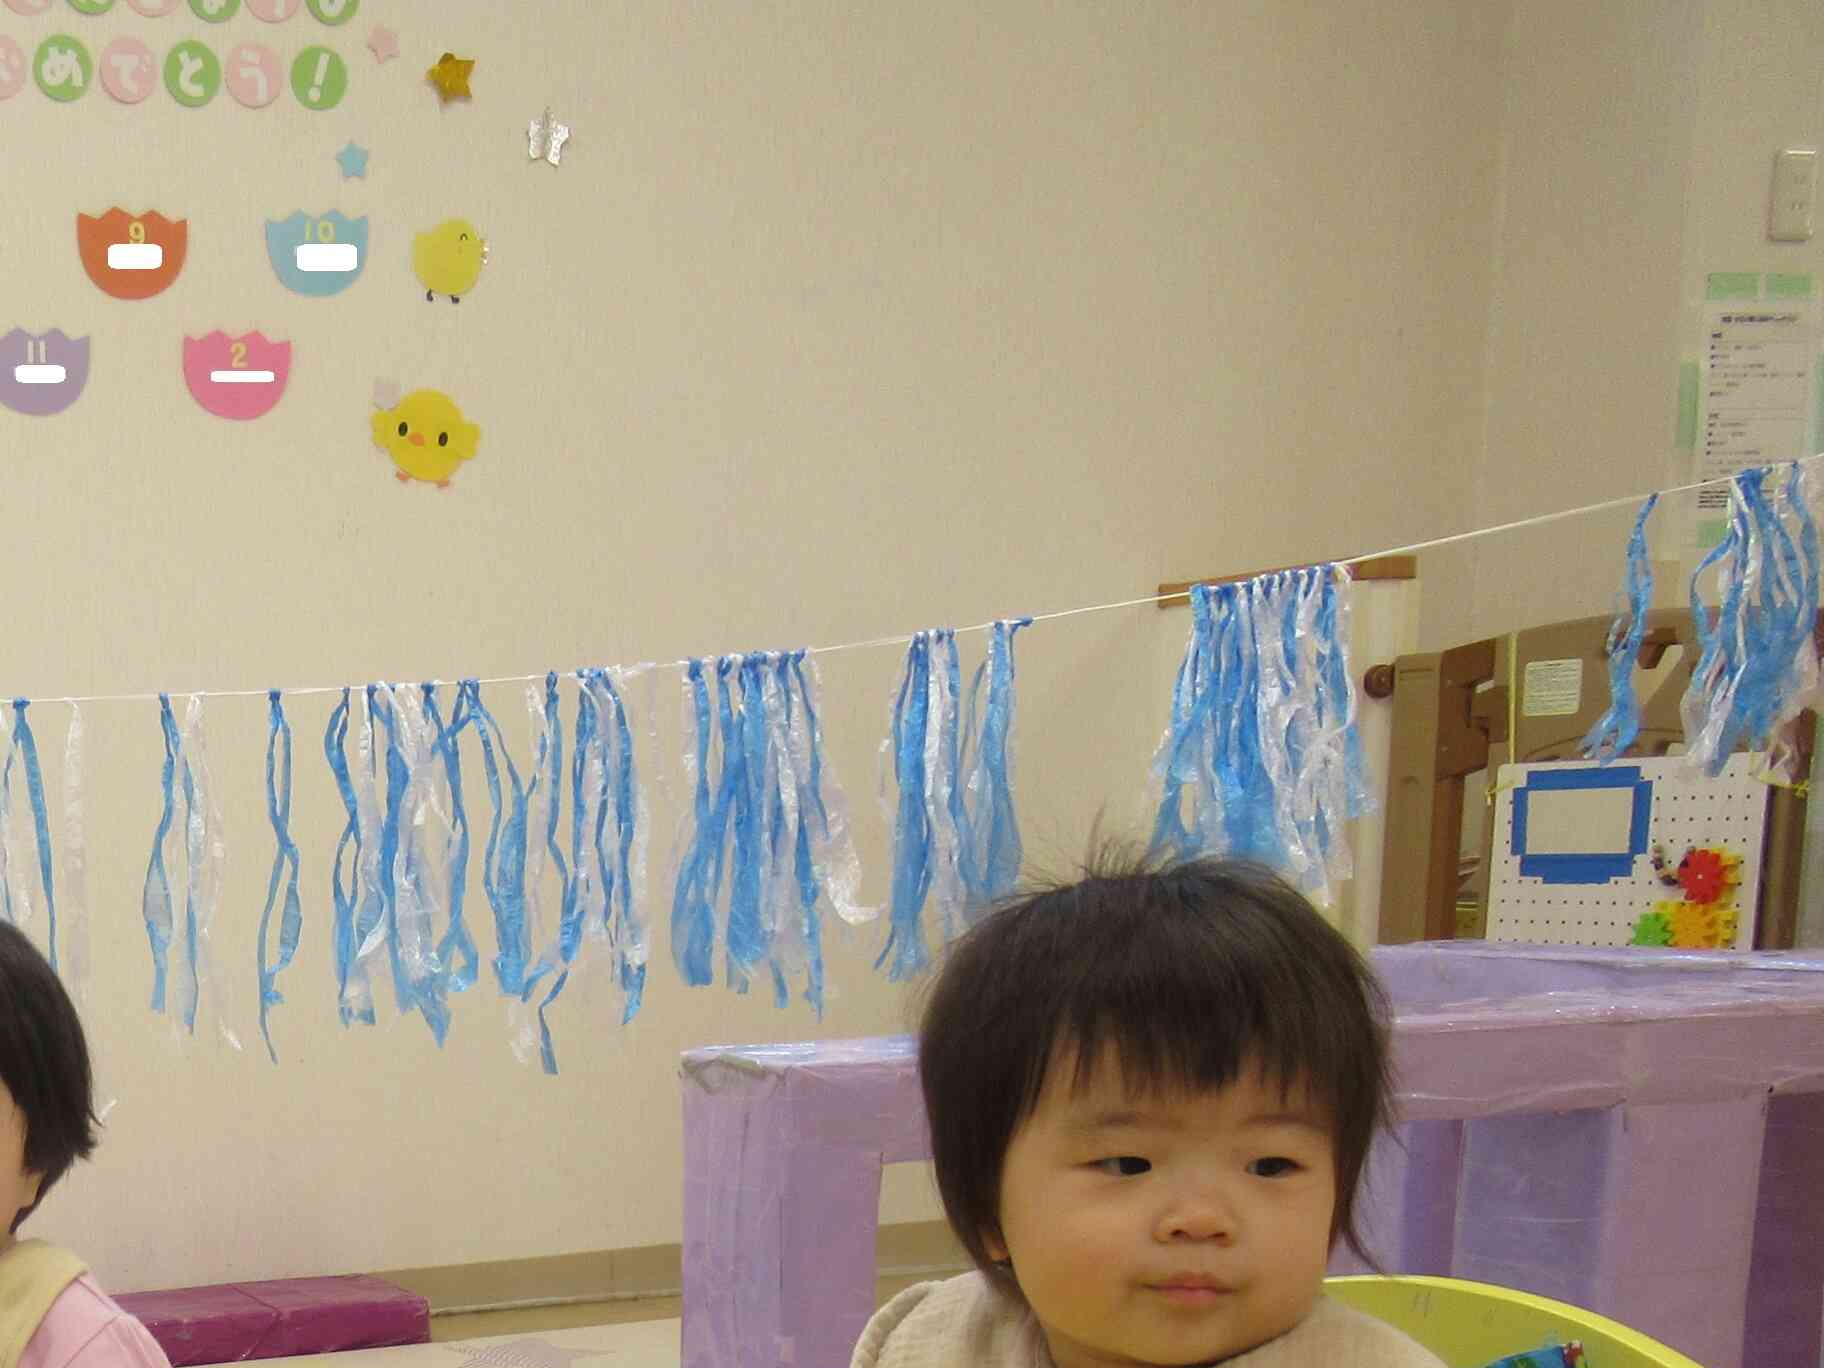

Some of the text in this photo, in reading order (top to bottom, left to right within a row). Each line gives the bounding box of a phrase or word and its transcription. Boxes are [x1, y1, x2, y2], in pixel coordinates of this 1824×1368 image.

[128, 221, 146, 244] 9
[304, 220, 337, 243] 10
[230, 342, 249, 369] 2
